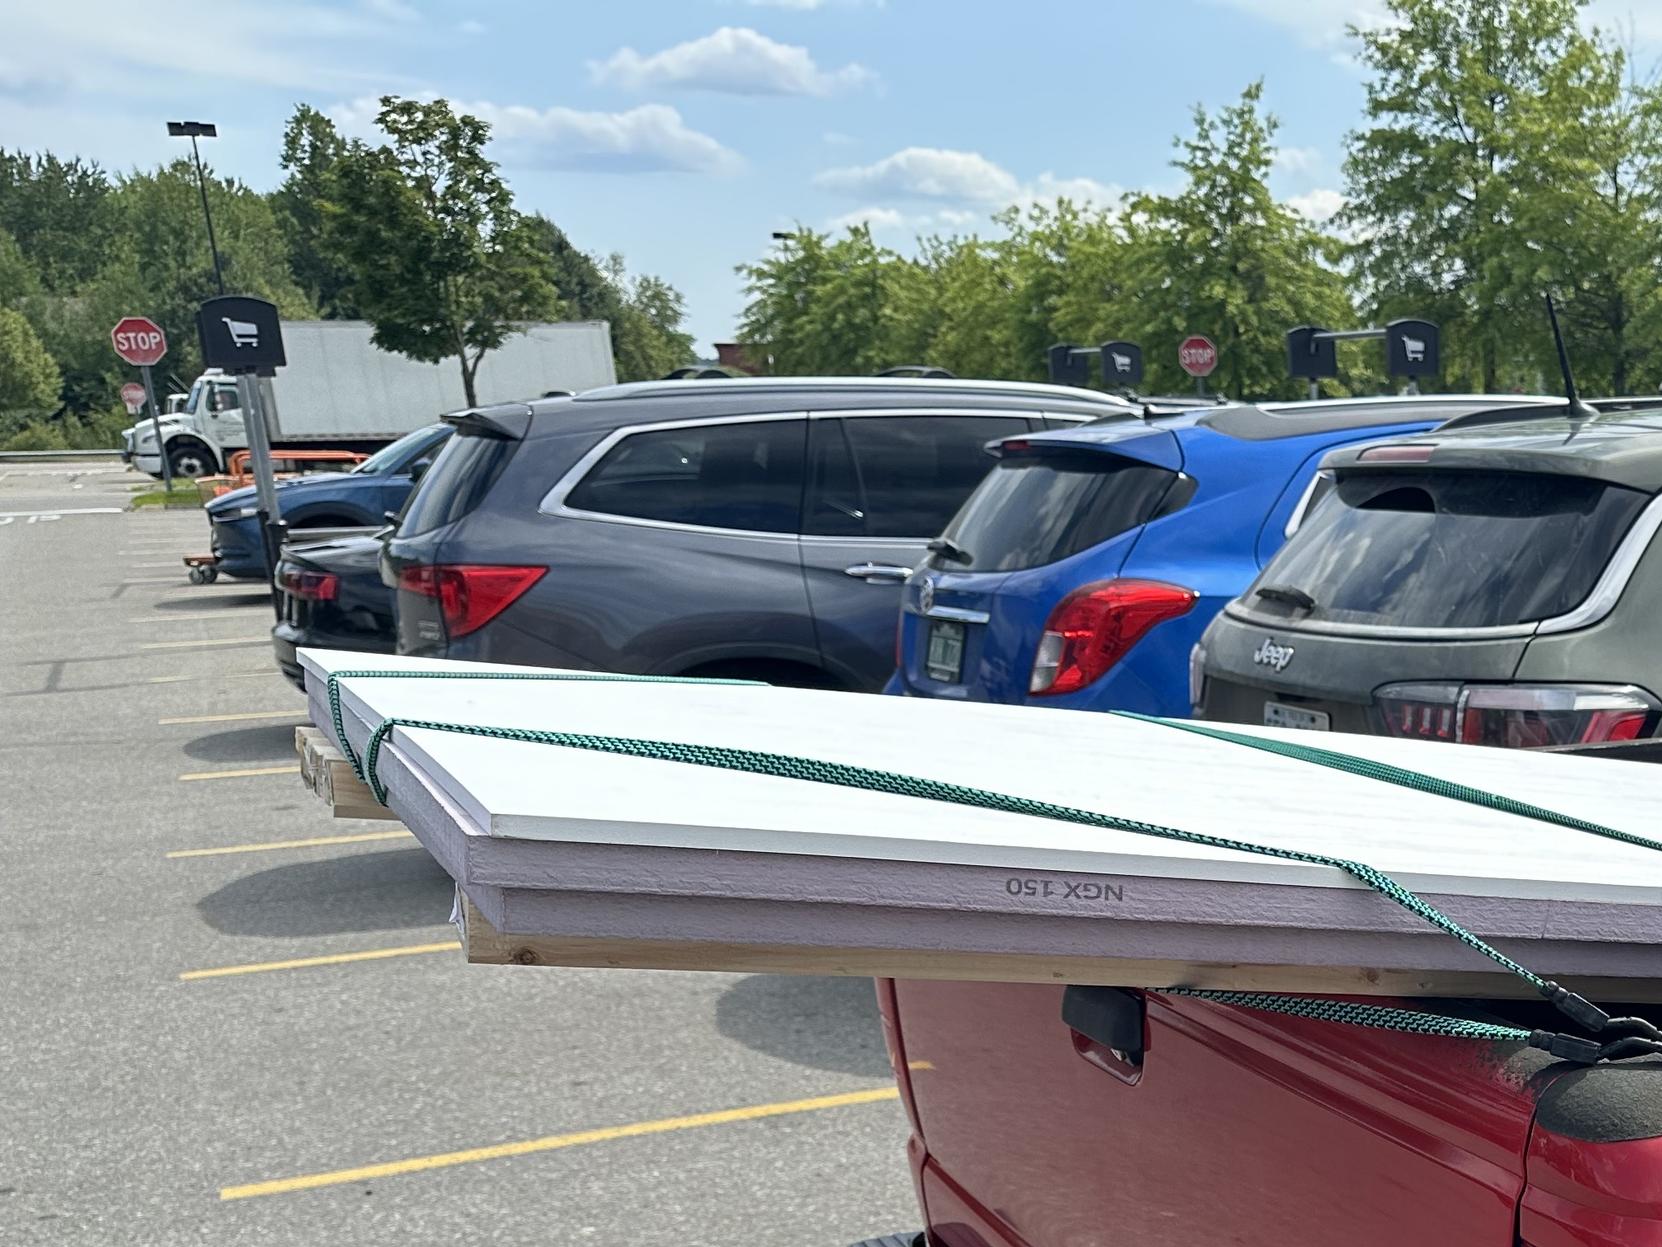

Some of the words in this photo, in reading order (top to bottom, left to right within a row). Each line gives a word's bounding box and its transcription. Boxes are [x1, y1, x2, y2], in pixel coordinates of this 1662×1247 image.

[116, 332, 160, 350] STOP
[1183, 348, 1214, 364] STOP
[1254, 638, 1295, 671] Jeep
[1005, 877, 1054, 898] 150
[1063, 881, 1124, 902] NGX
